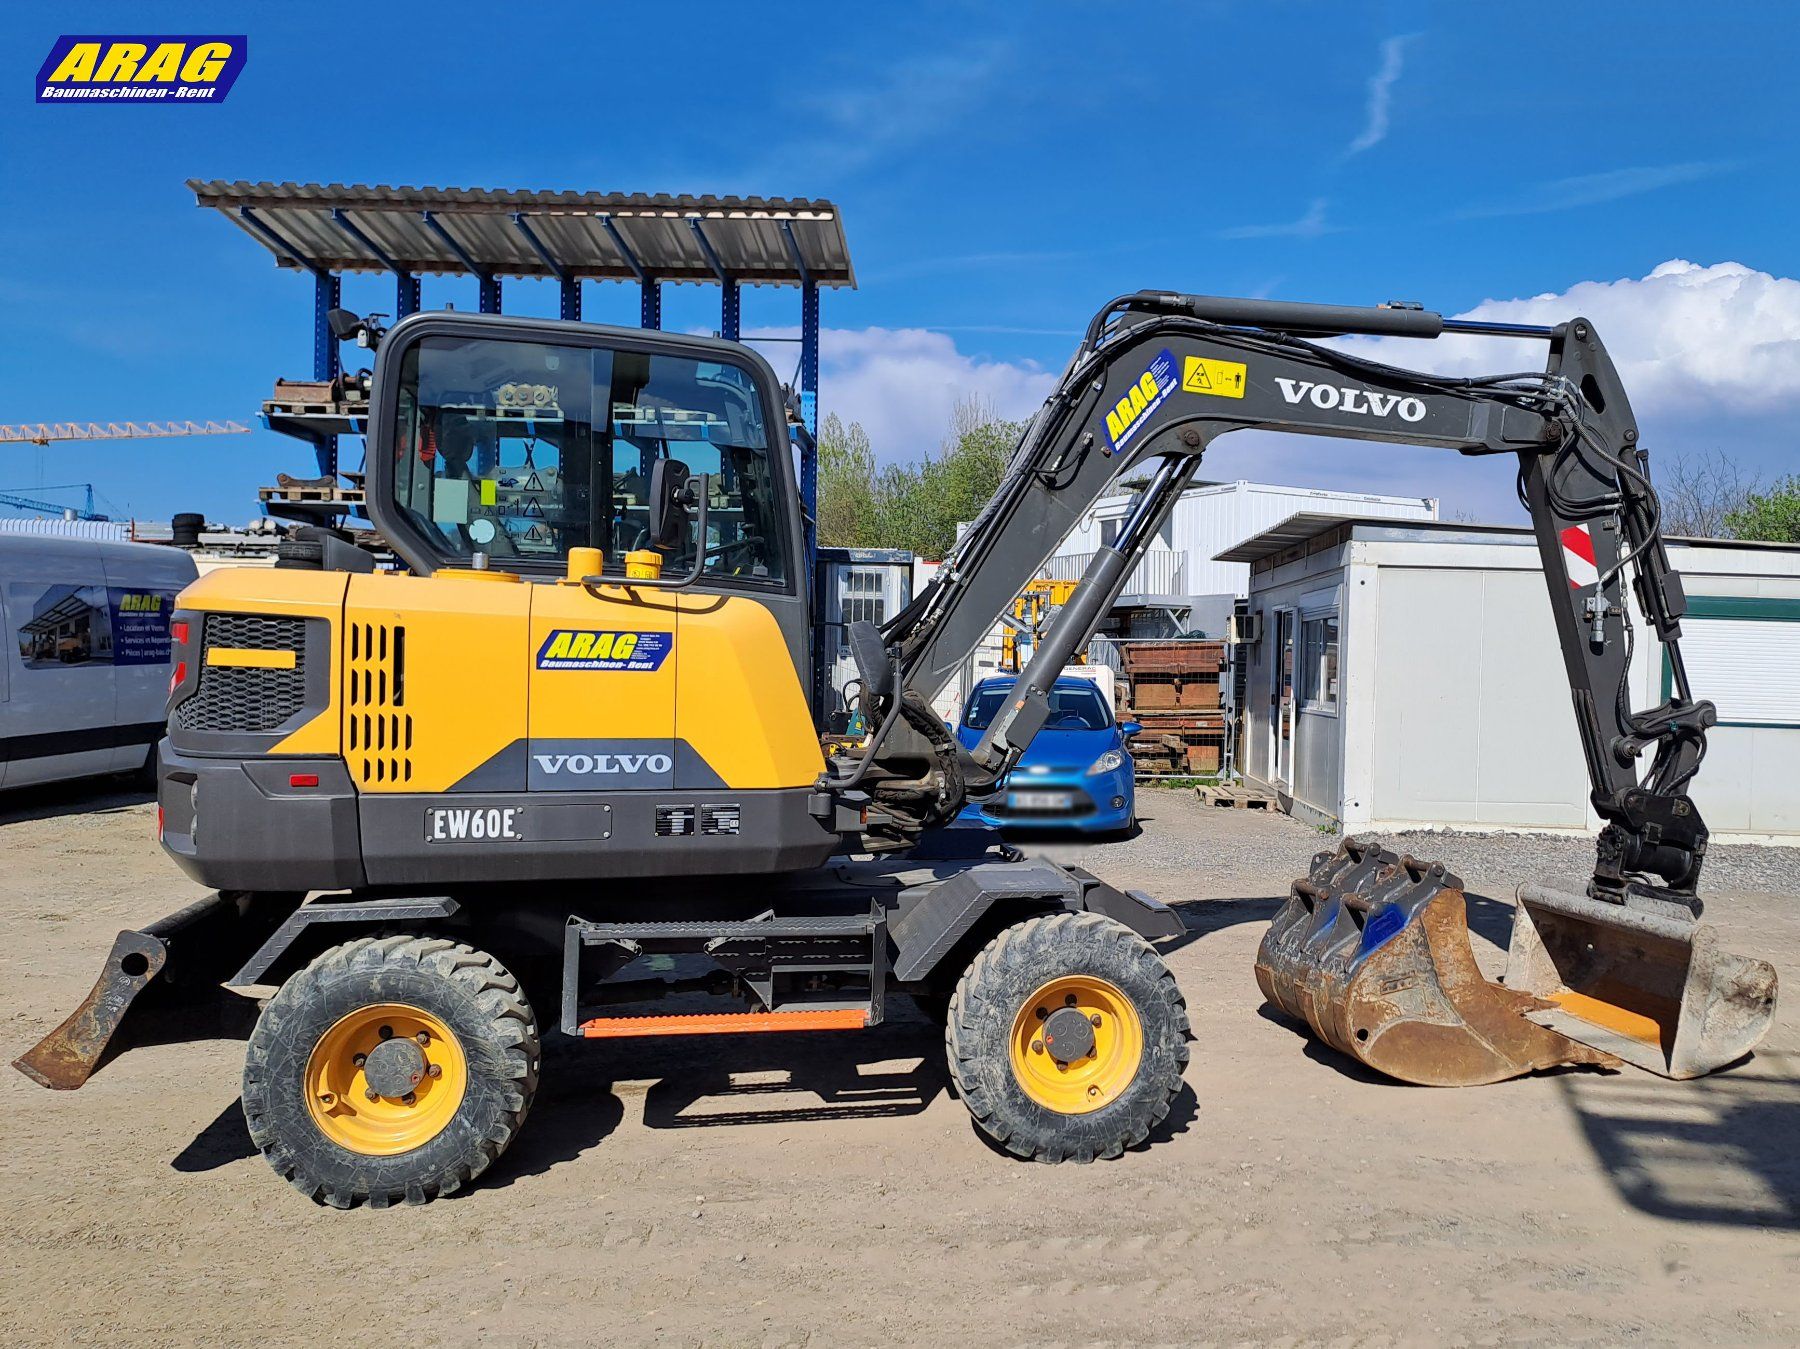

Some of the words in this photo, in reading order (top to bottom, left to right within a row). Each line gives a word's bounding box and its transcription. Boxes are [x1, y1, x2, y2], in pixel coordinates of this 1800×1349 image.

[1105, 371, 1160, 443] ARAG
[1274, 377, 1427, 423] VOLVO
[119, 594, 161, 611] ARAG
[544, 632, 639, 660] ARAG
[533, 753, 673, 774] VOLVO
[433, 808, 516, 839] EW60E
